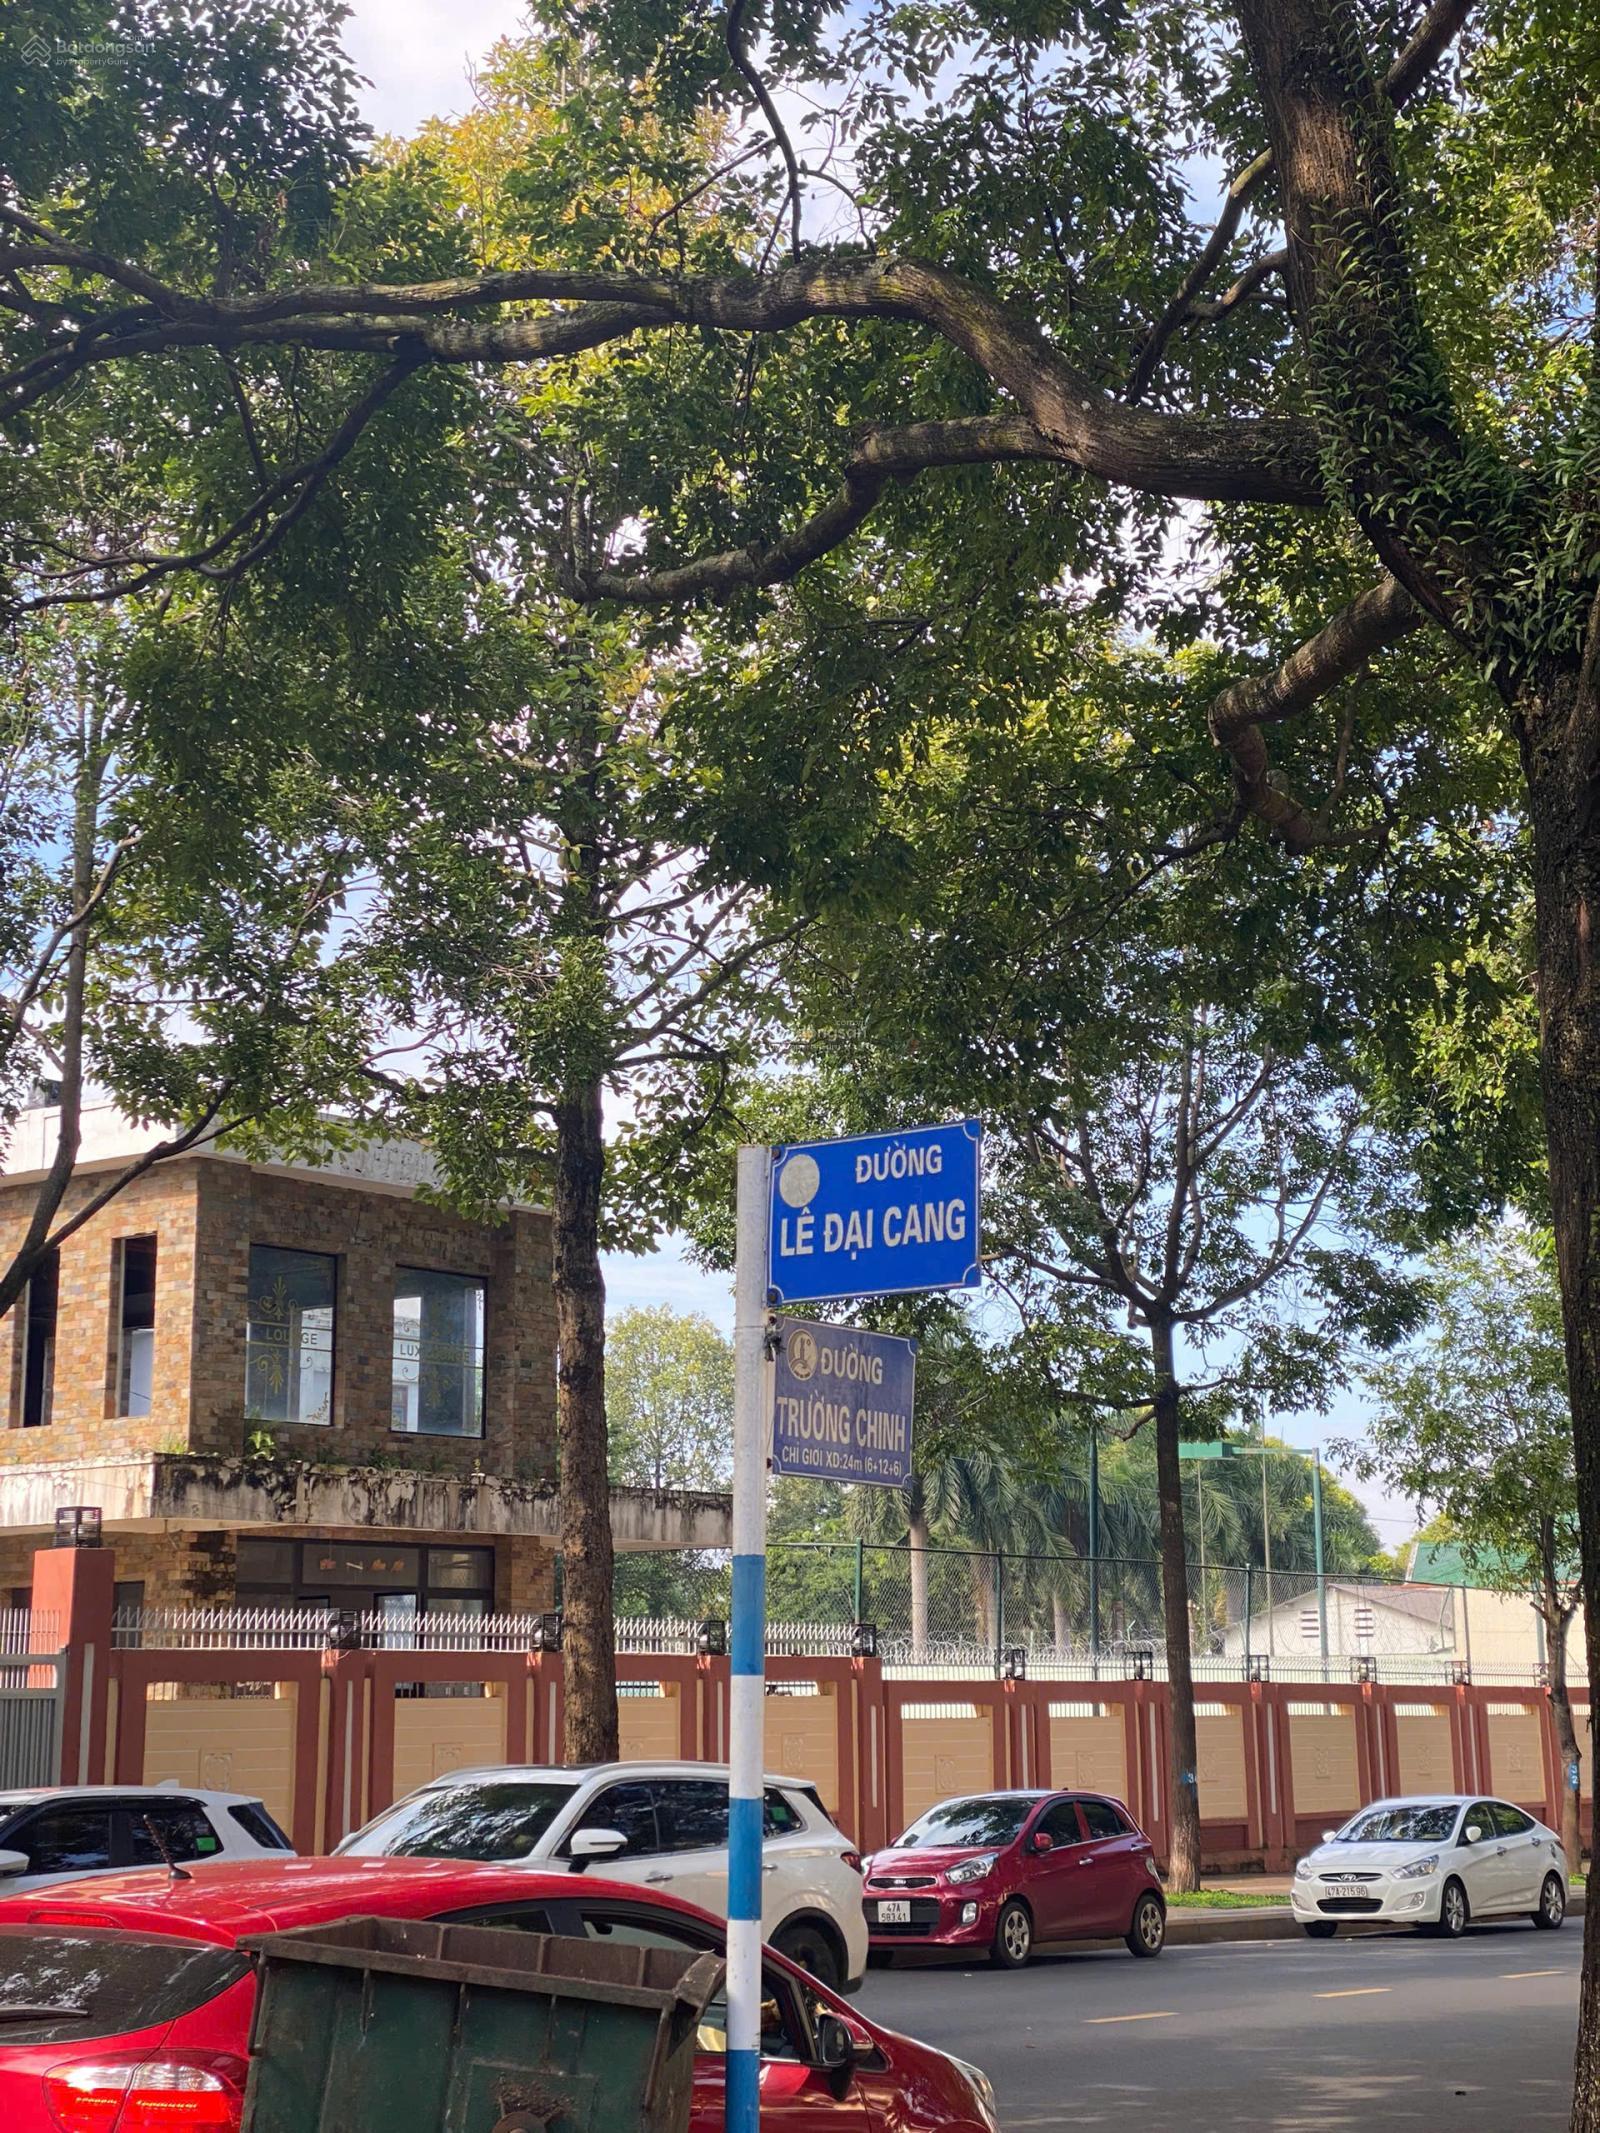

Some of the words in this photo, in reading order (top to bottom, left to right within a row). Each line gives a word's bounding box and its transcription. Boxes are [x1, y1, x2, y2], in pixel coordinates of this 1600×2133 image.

[855, 1141, 943, 1184] ĐƯỜNG
[780, 1206, 815, 1257] LÊ
[823, 1208, 874, 1261] ĐẠI
[883, 1198, 966, 1248] CANG
[265, 1327, 318, 1345] LOUGE
[821, 1343, 883, 1385] ĐƯỜNG
[777, 1389, 851, 1445] TRƯỜNG
[856, 1408, 906, 1452] CHINH
[886, 1903, 901, 1912] 47A
